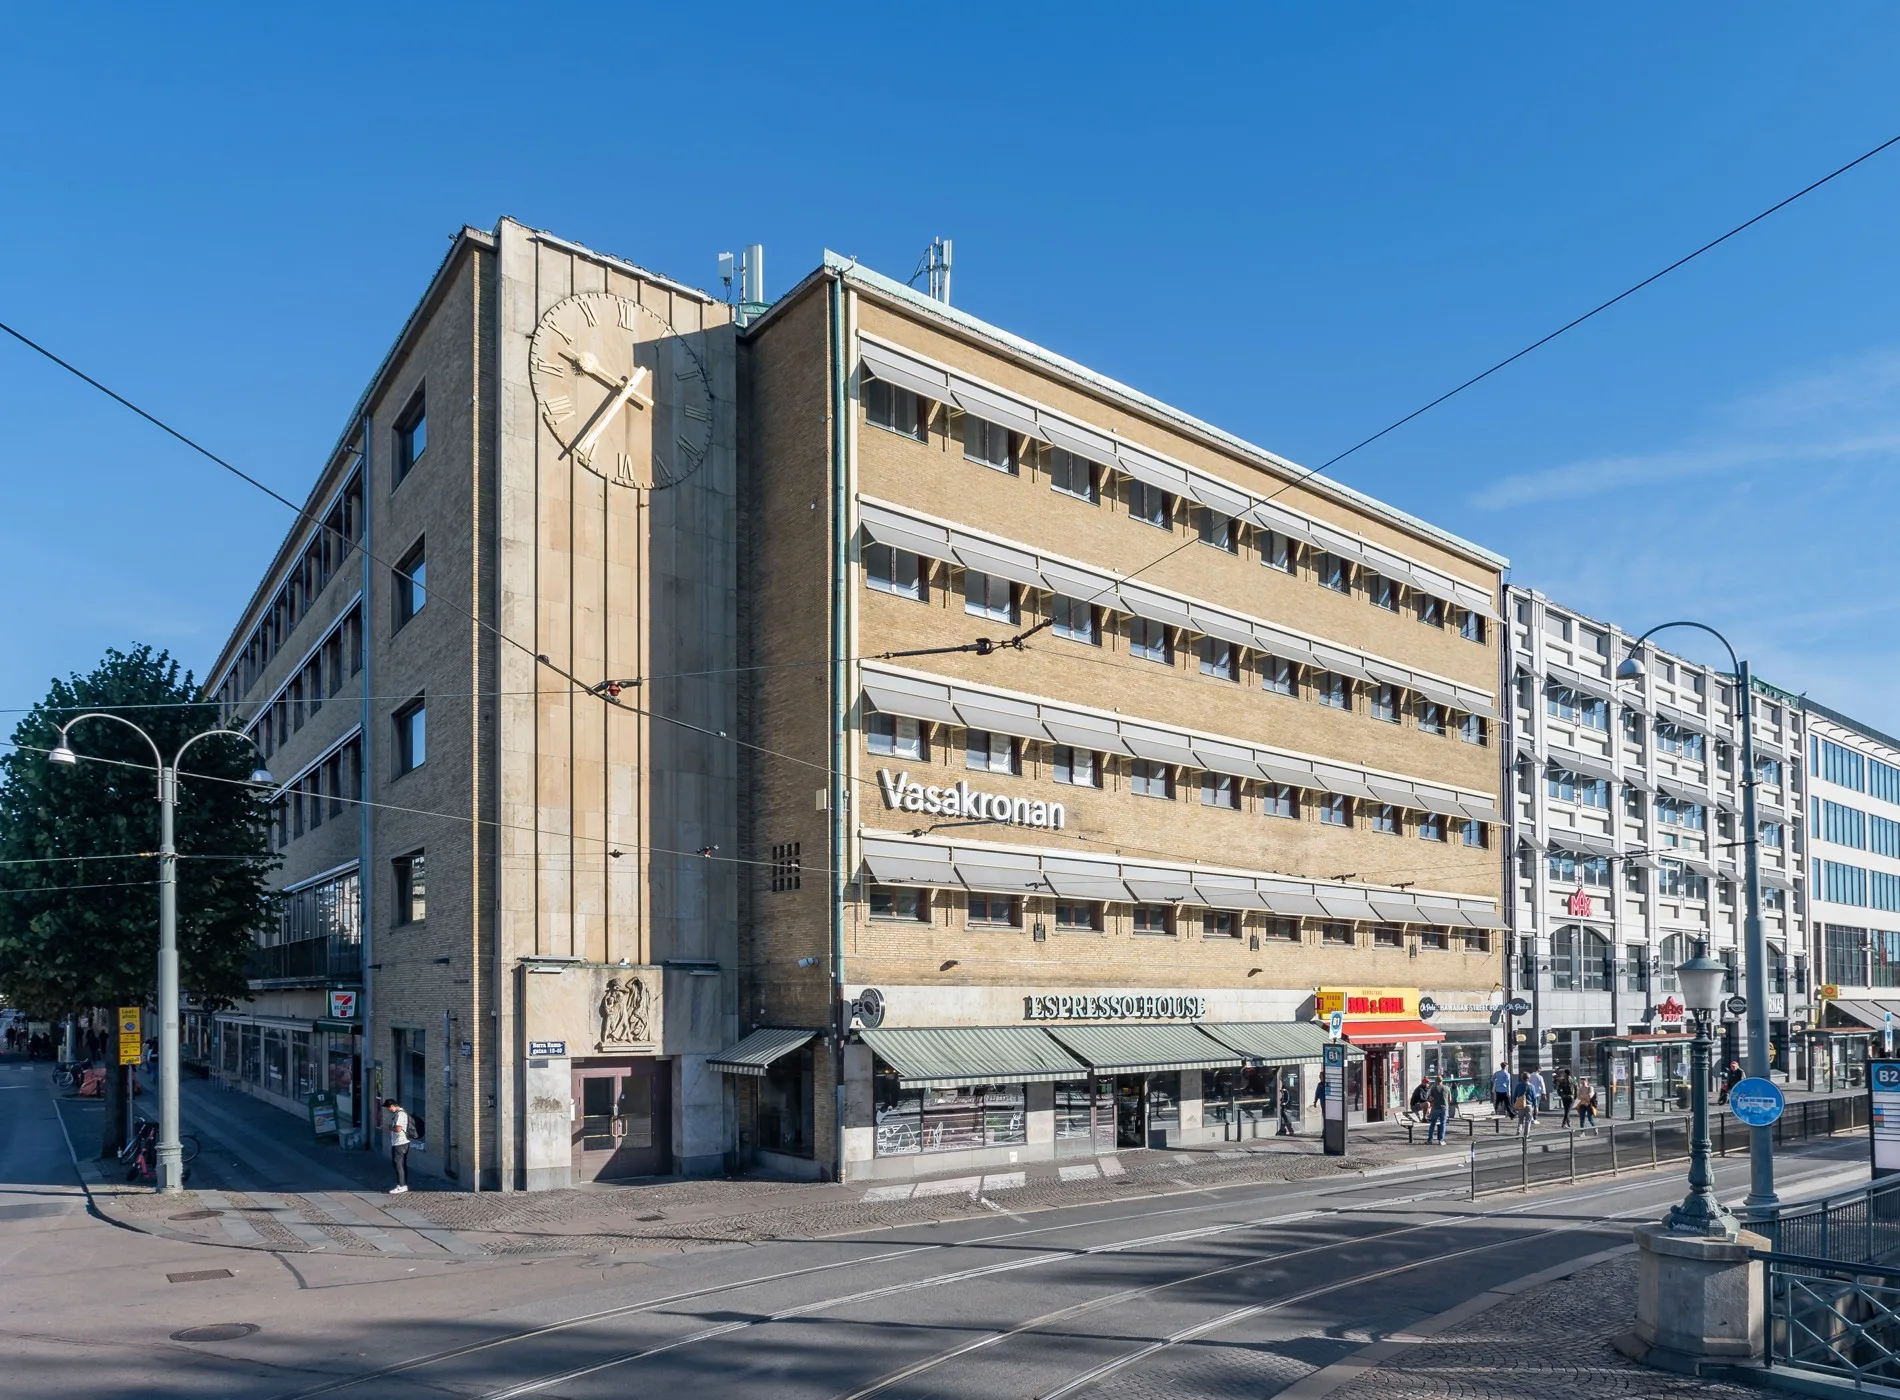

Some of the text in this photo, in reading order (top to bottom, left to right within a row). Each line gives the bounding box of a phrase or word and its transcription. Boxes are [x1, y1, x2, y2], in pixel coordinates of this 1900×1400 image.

[880, 768, 1065, 829] Vasakronan
[1570, 889, 1593, 917] MAX
[1029, 994, 1206, 1019] ESPRESSO HOUSE
[1379, 997, 1404, 1013] GRILL
[1768, 998, 1784, 1013] RNAS
[1332, 1018, 1340, 1026] B1
[1328, 1052, 1339, 1060] B1
[1880, 1070, 1898, 1082] B2
